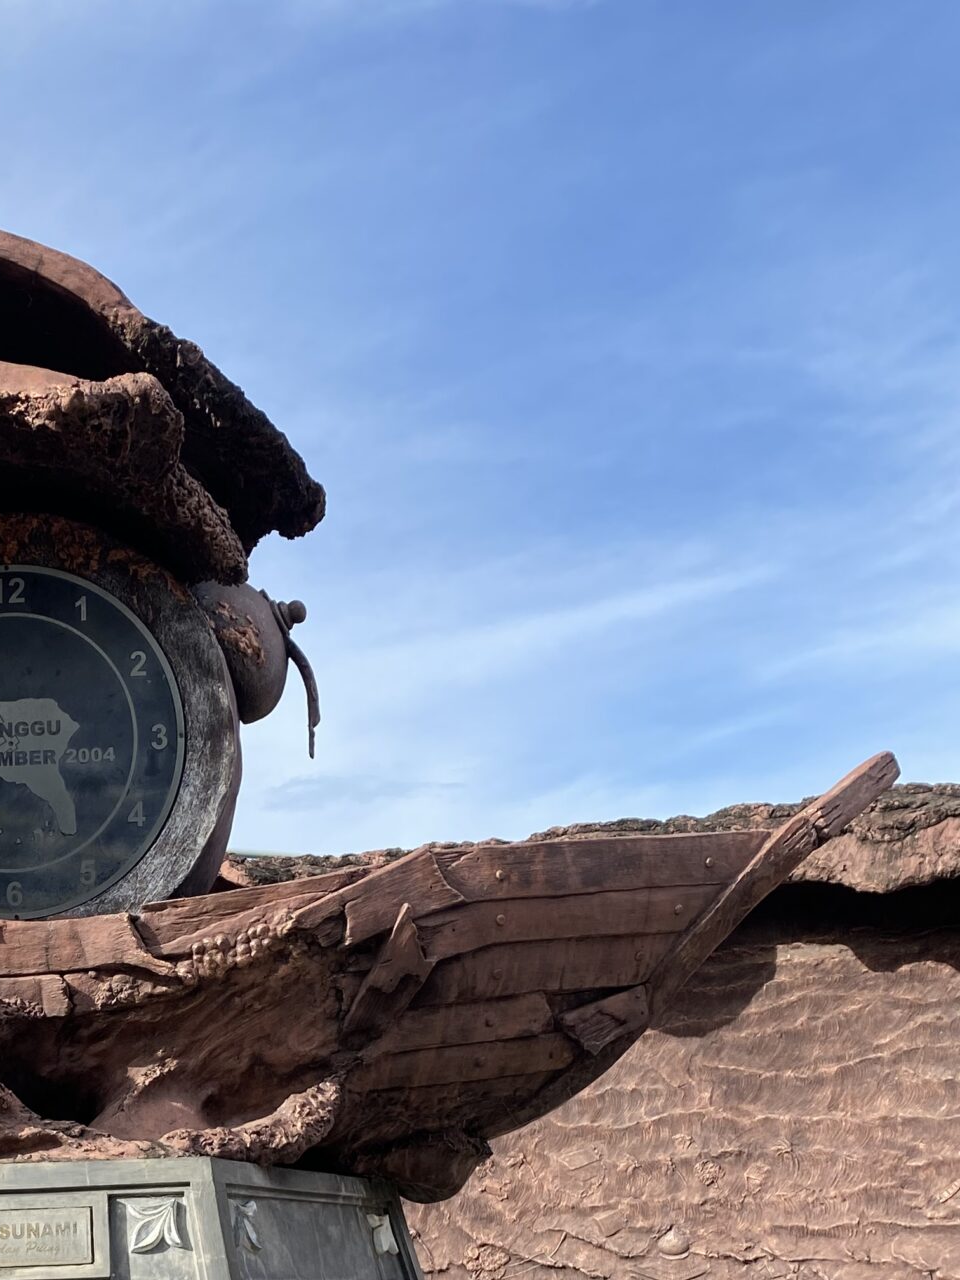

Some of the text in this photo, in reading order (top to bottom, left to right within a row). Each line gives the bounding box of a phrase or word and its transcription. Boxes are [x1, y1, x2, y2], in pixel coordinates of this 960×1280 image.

[74, 596, 87, 621] 1
[129, 651, 147, 677] 2
[151, 724, 168, 750] 3
[64, 747, 116, 764] 2004
[127, 802, 145, 826] 4
[80, 860, 96, 885] 5
[6, 881, 23, 906] 6
